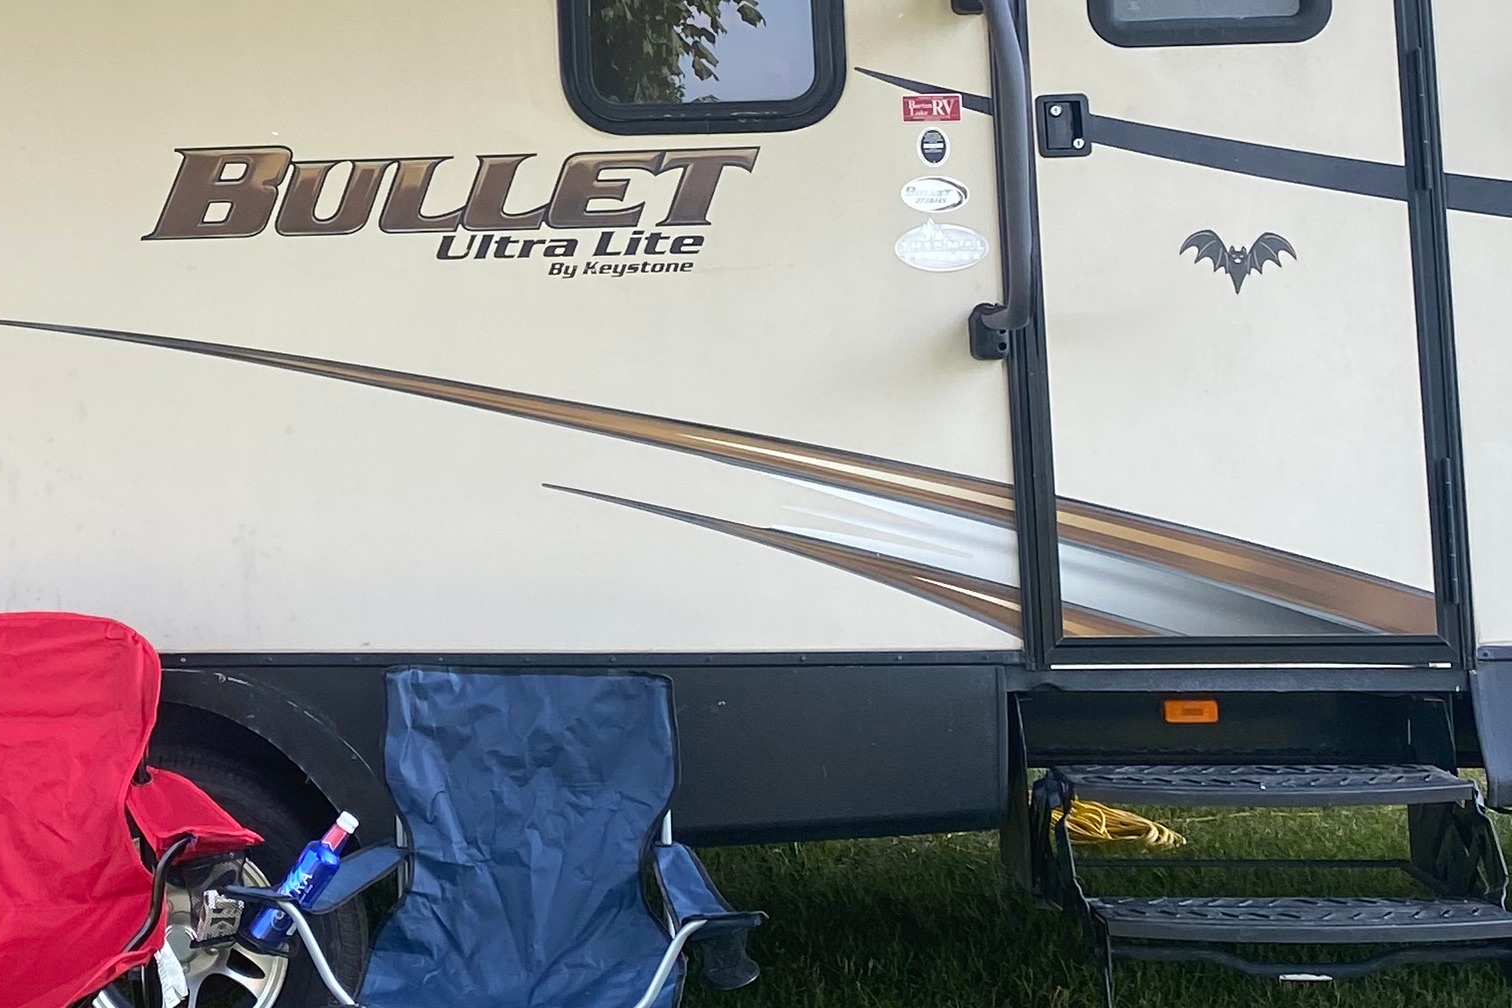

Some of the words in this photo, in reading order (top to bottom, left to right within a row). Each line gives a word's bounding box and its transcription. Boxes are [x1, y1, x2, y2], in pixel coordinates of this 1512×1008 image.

[932, 99, 955, 116] RV
[141, 145, 761, 240] BULLET
[436, 234, 578, 260] Ultra
[592, 230, 706, 257] Lite
[548, 262, 578, 279] By
[582, 260, 695, 278] Keystone
